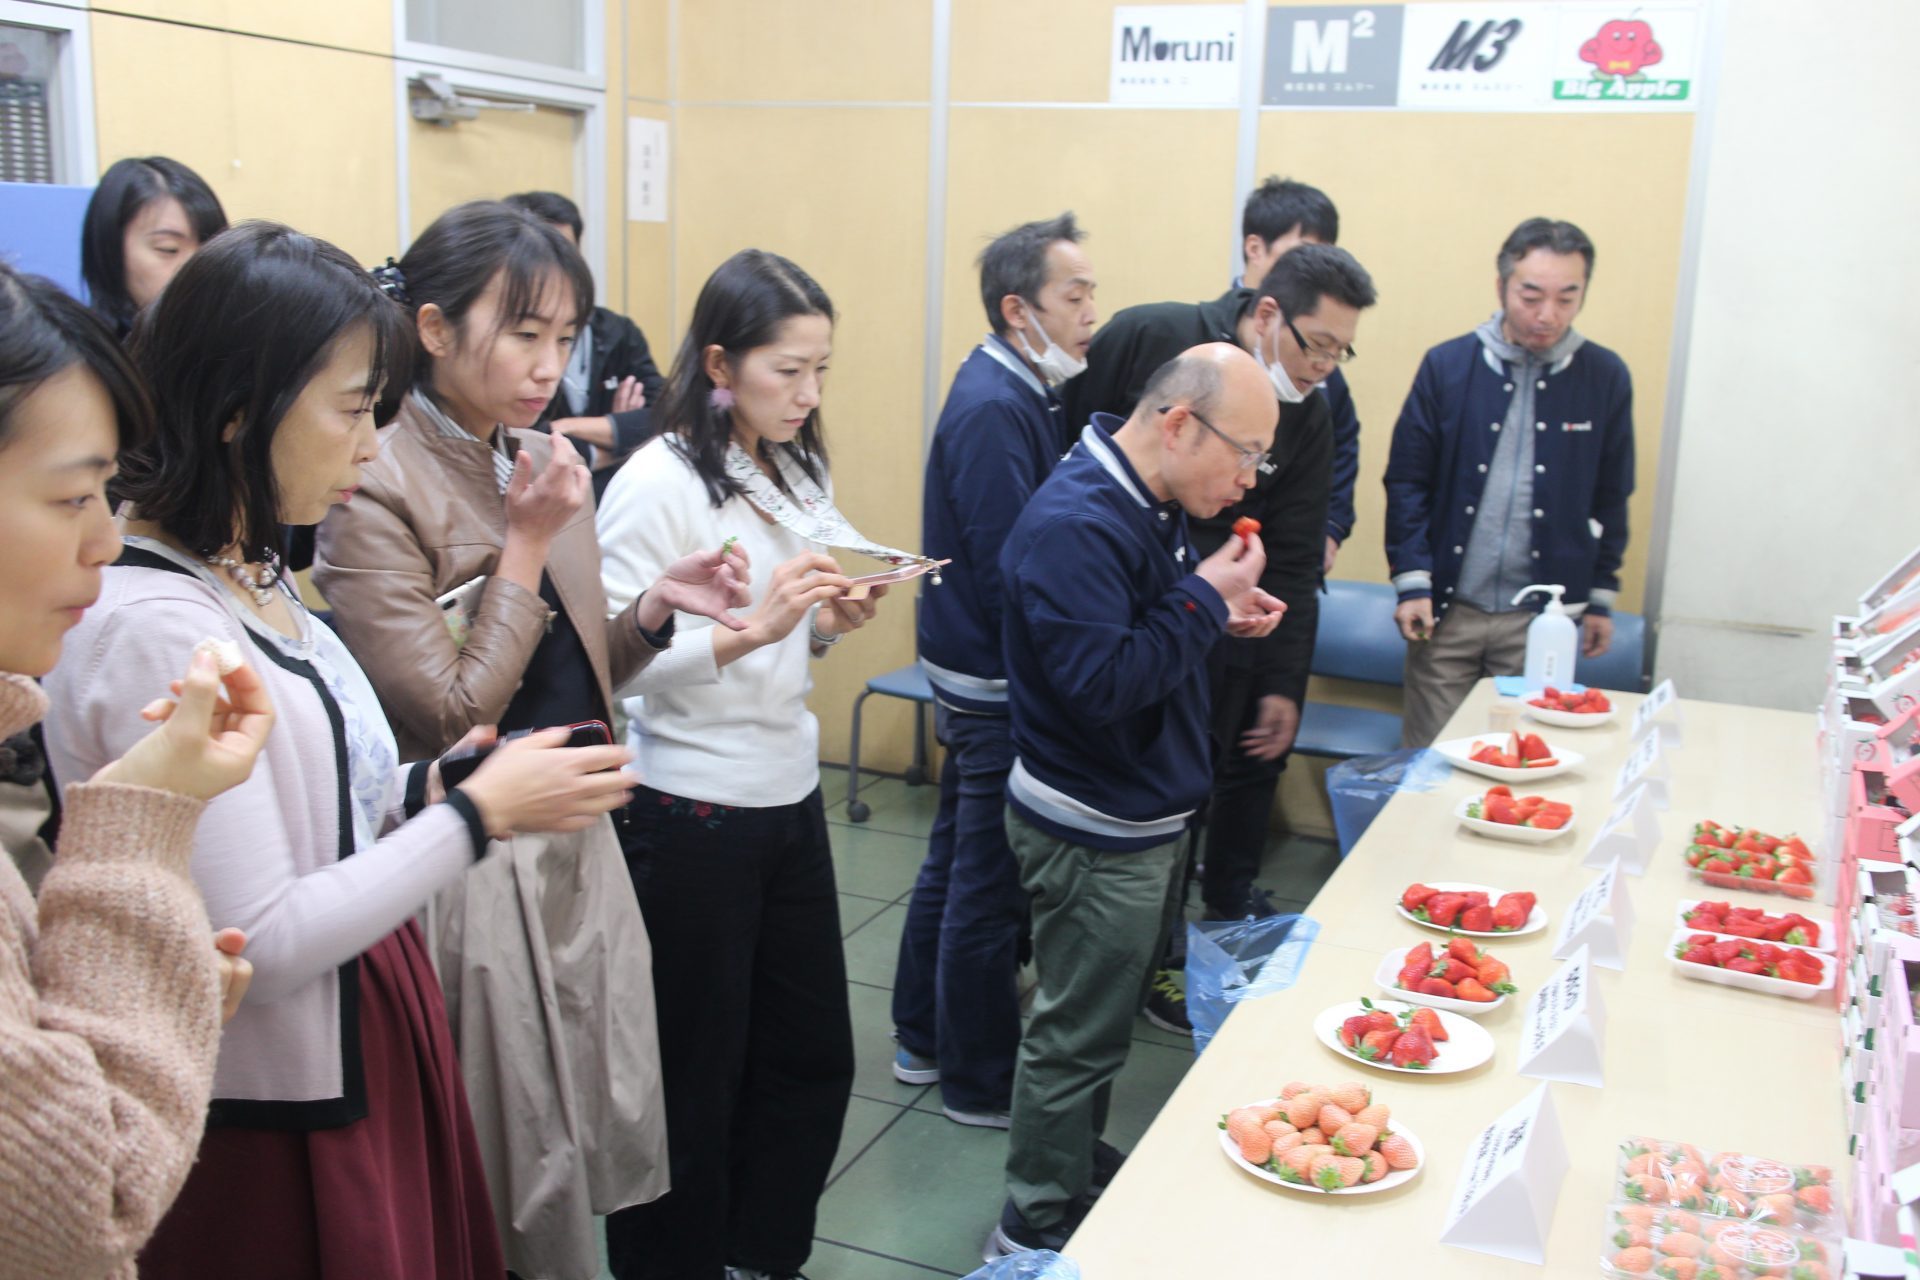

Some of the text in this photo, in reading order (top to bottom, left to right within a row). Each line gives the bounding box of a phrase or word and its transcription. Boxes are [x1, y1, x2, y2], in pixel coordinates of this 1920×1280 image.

[1427, 18, 1523, 73] M3
[1560, 75, 1682, 99] Big Apple
